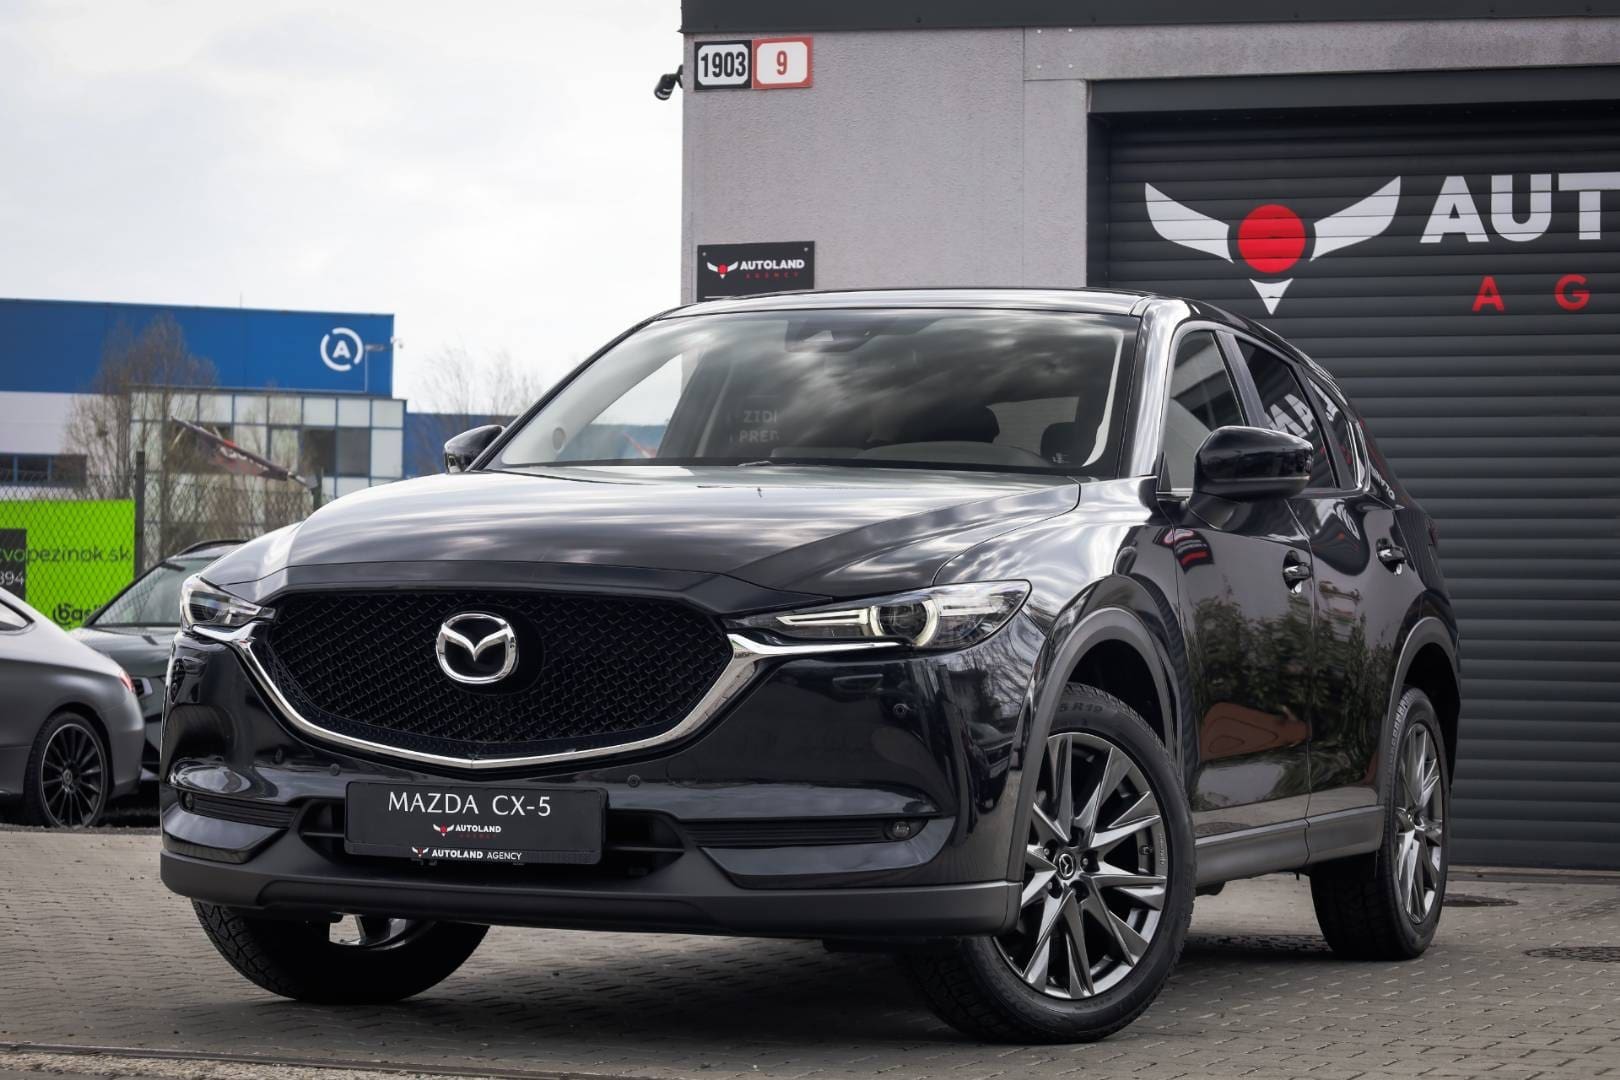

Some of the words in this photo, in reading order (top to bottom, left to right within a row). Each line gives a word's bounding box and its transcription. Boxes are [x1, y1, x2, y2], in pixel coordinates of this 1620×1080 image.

[700, 51, 747, 78] 1903
[776, 50, 788, 76] 9
[1420, 172, 1620, 243] AUT
[740, 259, 806, 271] AUTOLAND
[332, 339, 352, 359] A
[388, 791, 479, 815] MAZDA
[492, 795, 551, 817] CX-5
[455, 824, 502, 833] AUTOLAND
[431, 849, 484, 859] AUTOLAND
[486, 851, 522, 861] AGENCY
